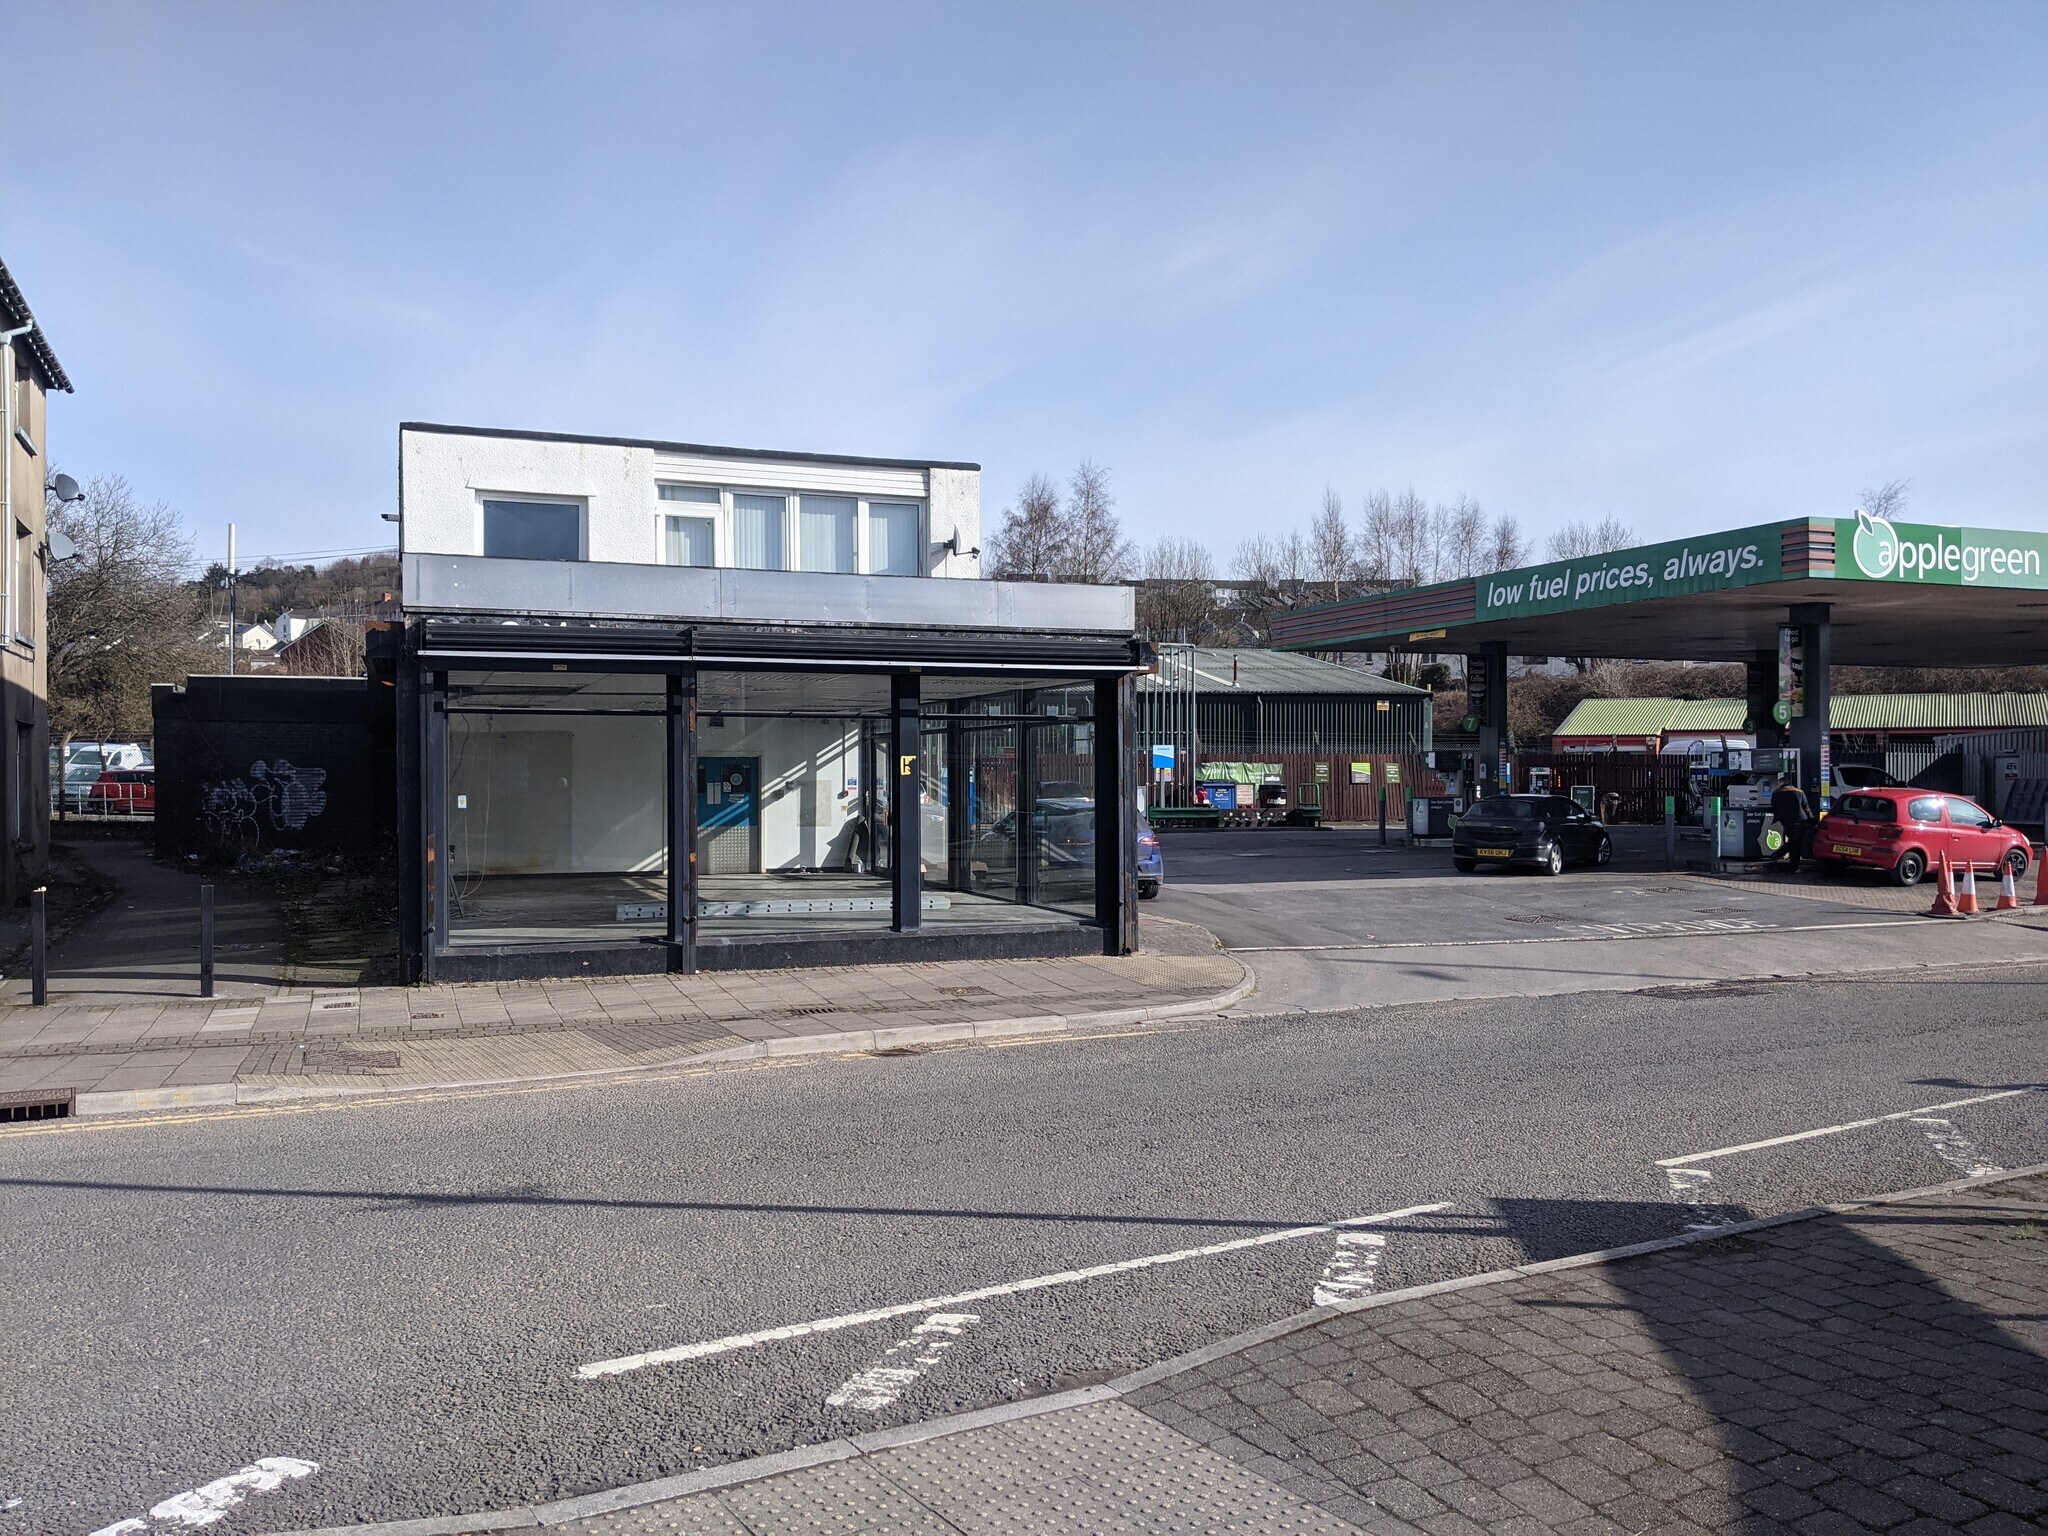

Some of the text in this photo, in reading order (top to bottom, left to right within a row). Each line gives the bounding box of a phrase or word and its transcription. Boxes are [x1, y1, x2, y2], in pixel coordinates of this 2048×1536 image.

[1878, 533, 2040, 582] applegreen
[1486, 544, 1764, 608] low fuel prices, always.
[1784, 628, 1799, 636] Food
[1779, 705, 1787, 720] 5
[1467, 717, 1475, 729] 7
[1747, 720, 1754, 732] 3
